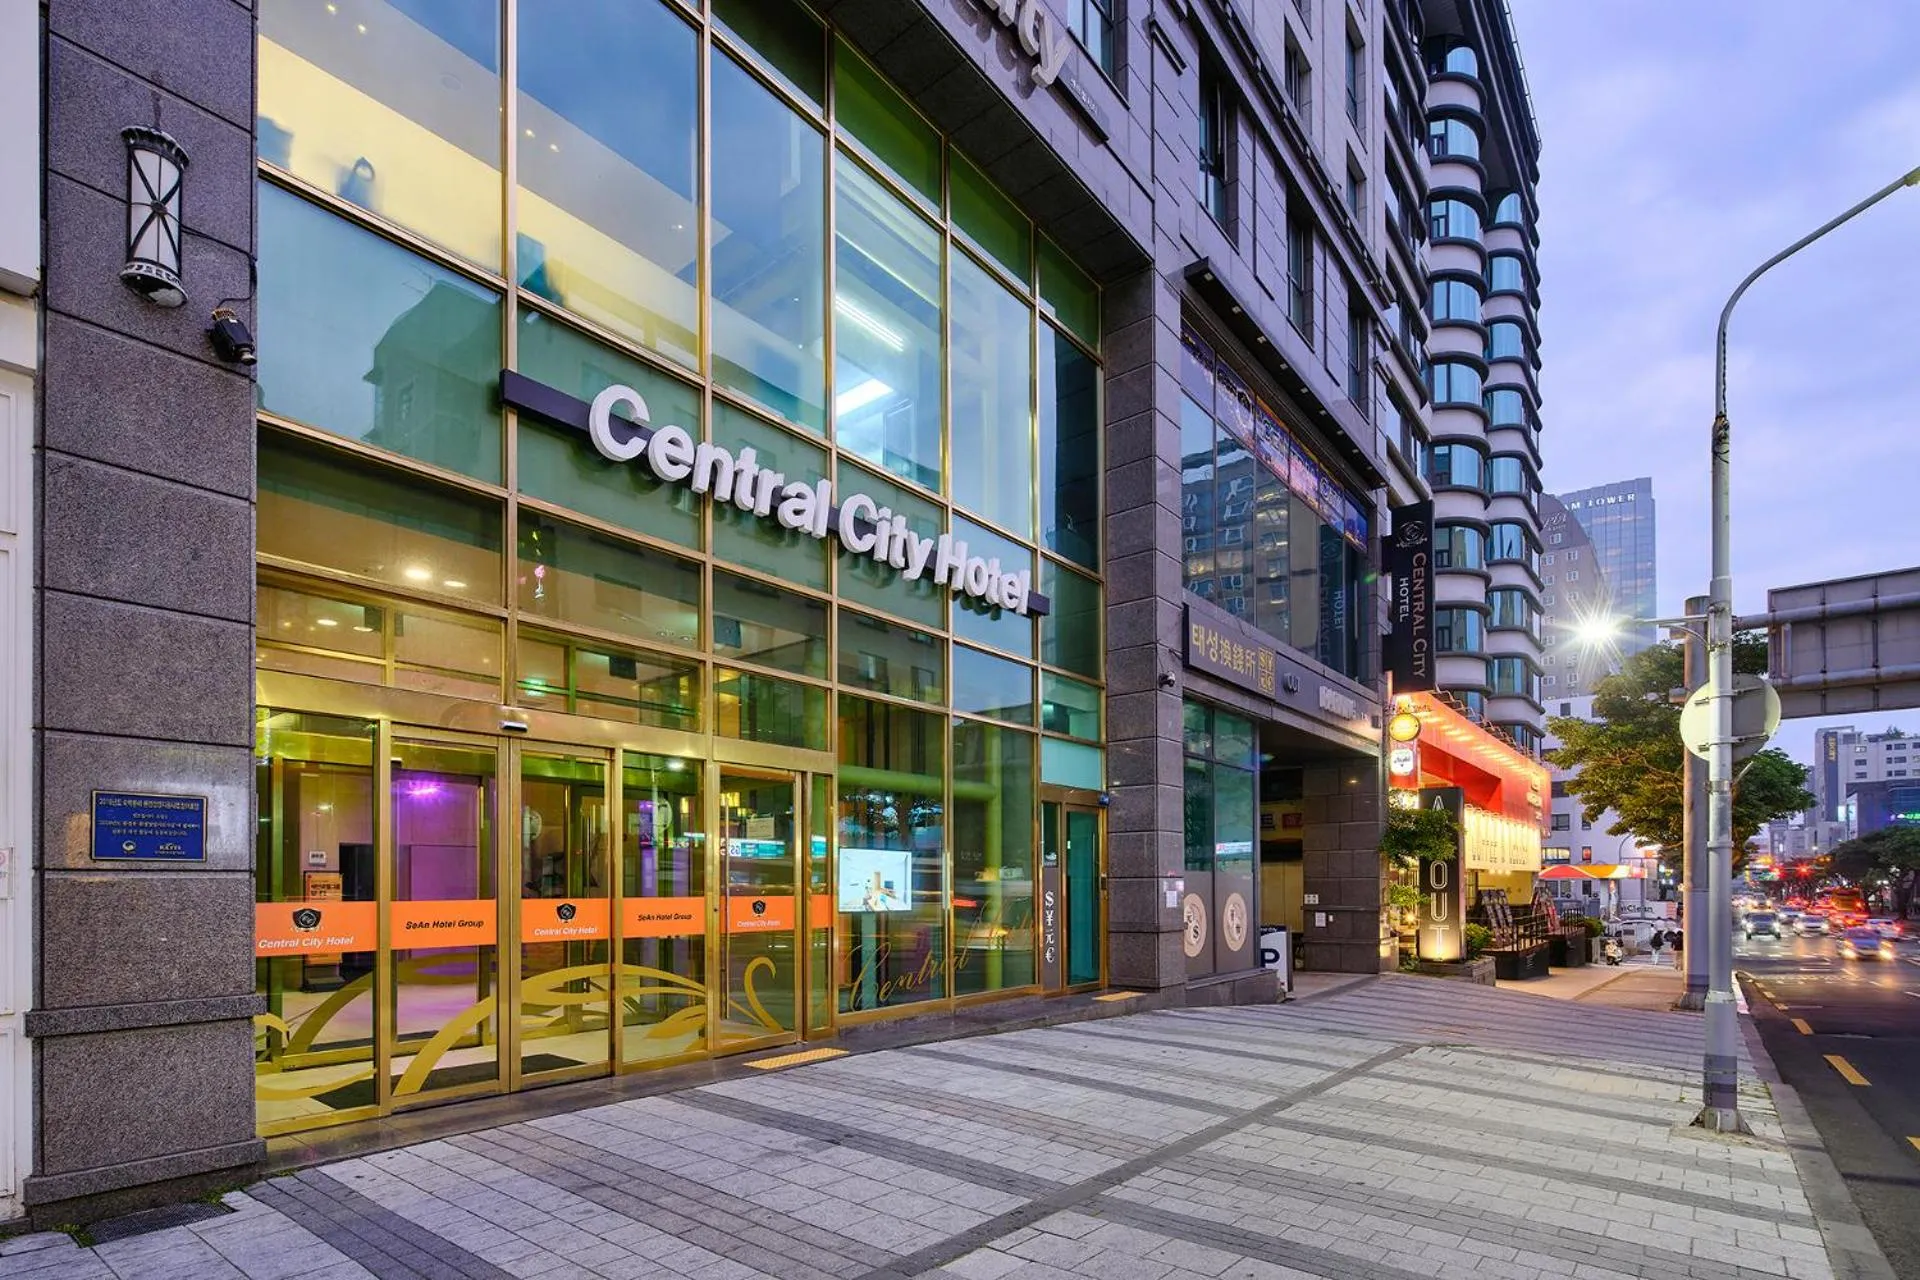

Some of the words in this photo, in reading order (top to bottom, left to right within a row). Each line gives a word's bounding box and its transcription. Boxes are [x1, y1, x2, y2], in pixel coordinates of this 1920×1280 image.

[589, 384, 832, 539] Central
[839, 493, 934, 582] City
[935, 533, 1031, 616] Hotel
[1588, 493, 1635, 507] TOWER
[1399, 577, 1409, 623] HOTEL
[1412, 552, 1427, 636] CENTRAL
[1412, 638, 1428, 679] CITY
[406, 921, 429, 930] SeAn
[432, 920, 455, 928] Hotel
[458, 919, 484, 928] Group
[637, 914, 655, 922] SeAn
[656, 913, 672, 921] Hotel
[534, 927, 561, 936] Central
[258, 938, 299, 949] Central
[302, 938, 323, 949] City
[326, 936, 354, 946] Hotel
[1262, 948, 1286, 977] P
